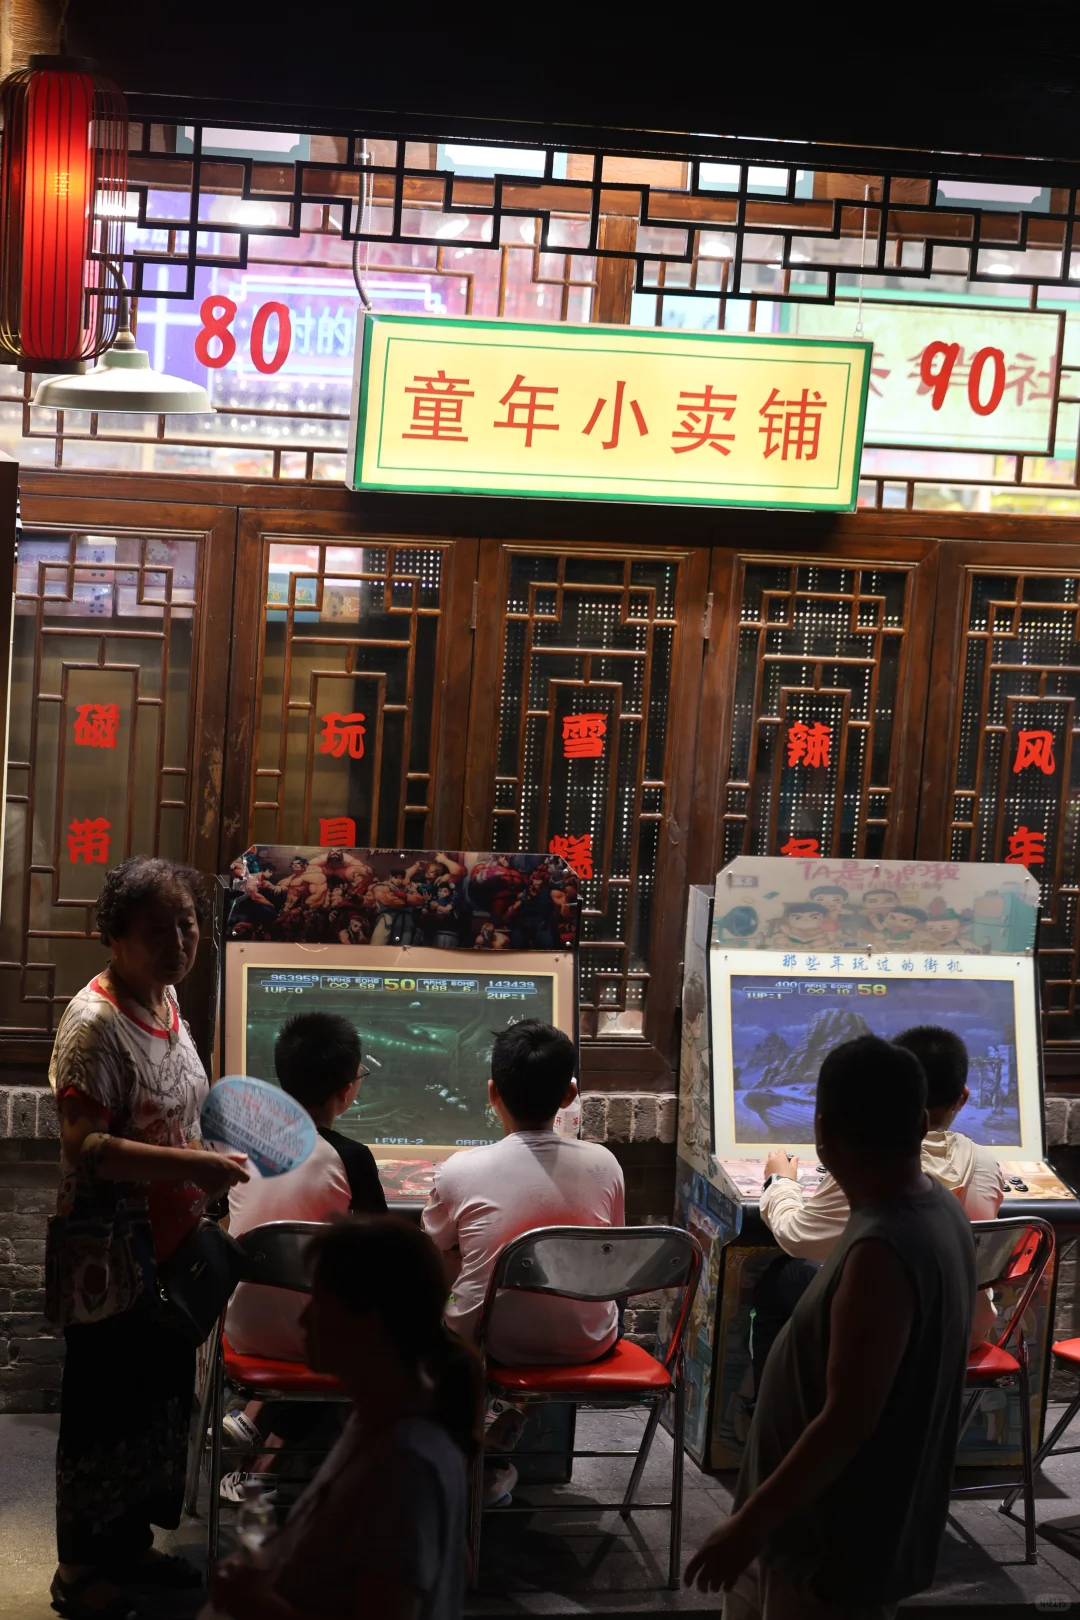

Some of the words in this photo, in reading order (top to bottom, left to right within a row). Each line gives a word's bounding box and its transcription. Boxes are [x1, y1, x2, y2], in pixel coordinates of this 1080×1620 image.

[195, 295, 292, 375] 80
[401, 369, 829, 462] 童年小卖铺
[920, 340, 1006, 417] 90
[67, 703, 120, 865] 磁带
[549, 712, 607, 880] 雪糕
[1004, 730, 1056, 869] 风车
[270, 973, 319, 982] 963959
[384, 978, 416, 992] 50
[746, 991, 783, 1000] 1UP=1
[782, 953, 964, 974] 那些年玩过的街机
[857, 983, 888, 996] 58
[374, 1137, 424, 1145] LEVEL-2
